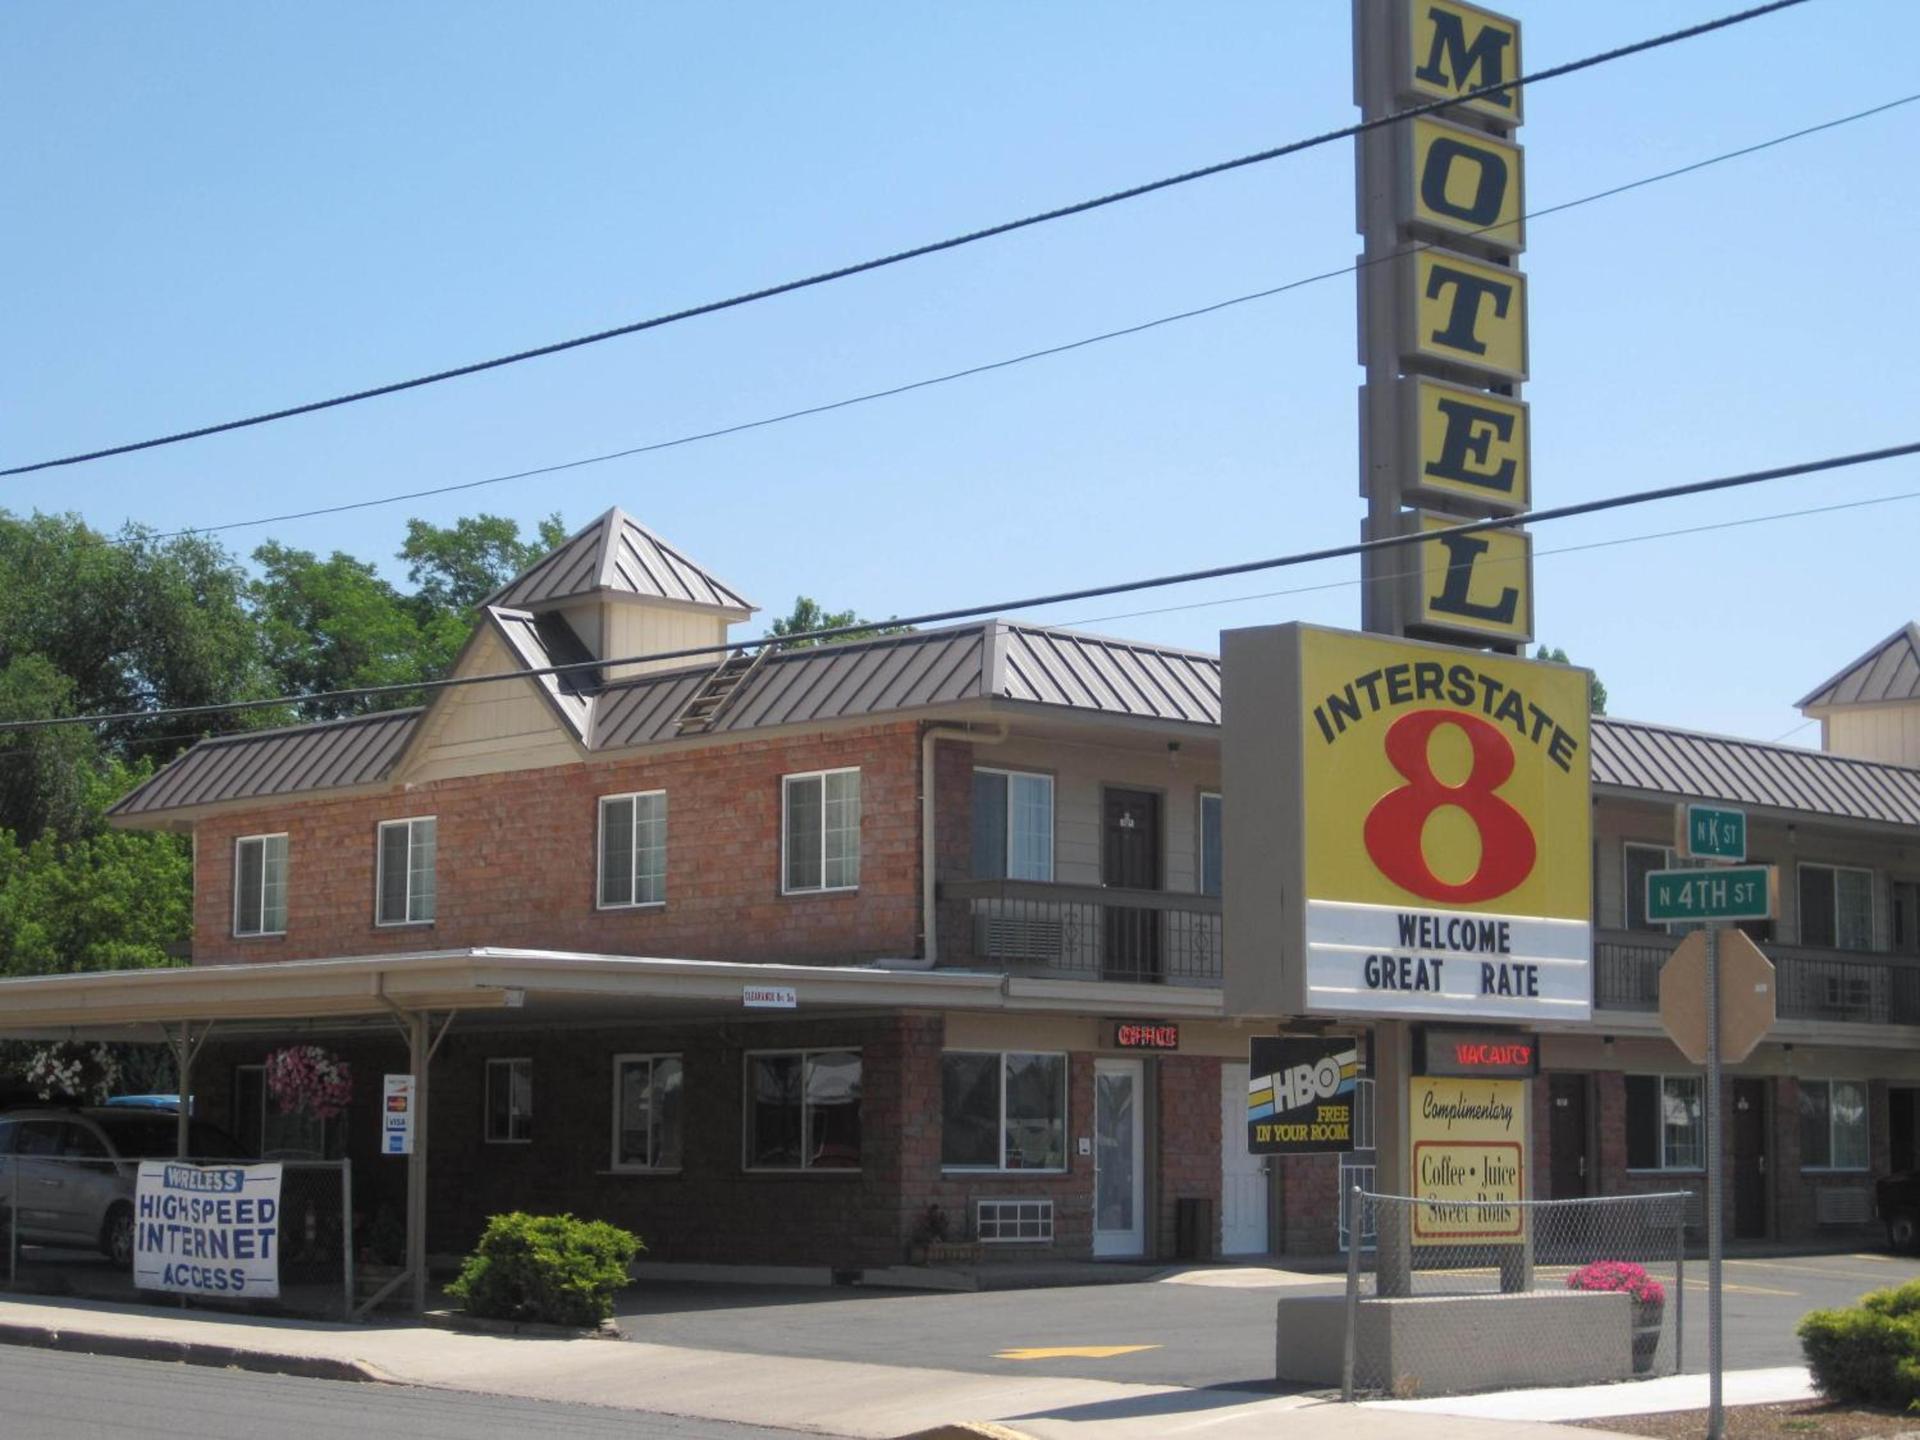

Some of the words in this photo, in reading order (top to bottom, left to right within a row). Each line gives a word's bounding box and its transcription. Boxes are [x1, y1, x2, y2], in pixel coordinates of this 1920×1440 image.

[1416, 7, 1519, 625] MOTEL
[1313, 661, 1578, 774] INTERSTATE
[1363, 708, 1537, 905] 8
[1697, 821, 1706, 841] N
[1709, 818, 1719, 847] K
[1723, 824, 1737, 844] ST
[1659, 887, 1670, 907] N
[1678, 880, 1727, 910] 4TH
[1734, 882, 1756, 904] ST
[1398, 913, 1511, 954] WELCOME
[1364, 955, 1444, 992] GREAT
[1481, 962, 1539, 997] RATE
[1272, 1057, 1342, 1114] HBO
[1317, 1106, 1350, 1122] FREE
[1422, 1089, 1514, 1131] Complimentary
[1256, 1124, 1272, 1142] IN
[1274, 1124, 1309, 1141] YOUR
[1311, 1123, 1350, 1140] ROOM
[1422, 1155, 1466, 1187] Coffee
[1481, 1155, 1516, 1189] Juice
[138, 1223, 276, 1260] INTERNET
[163, 1263, 246, 1291] ACCESS
